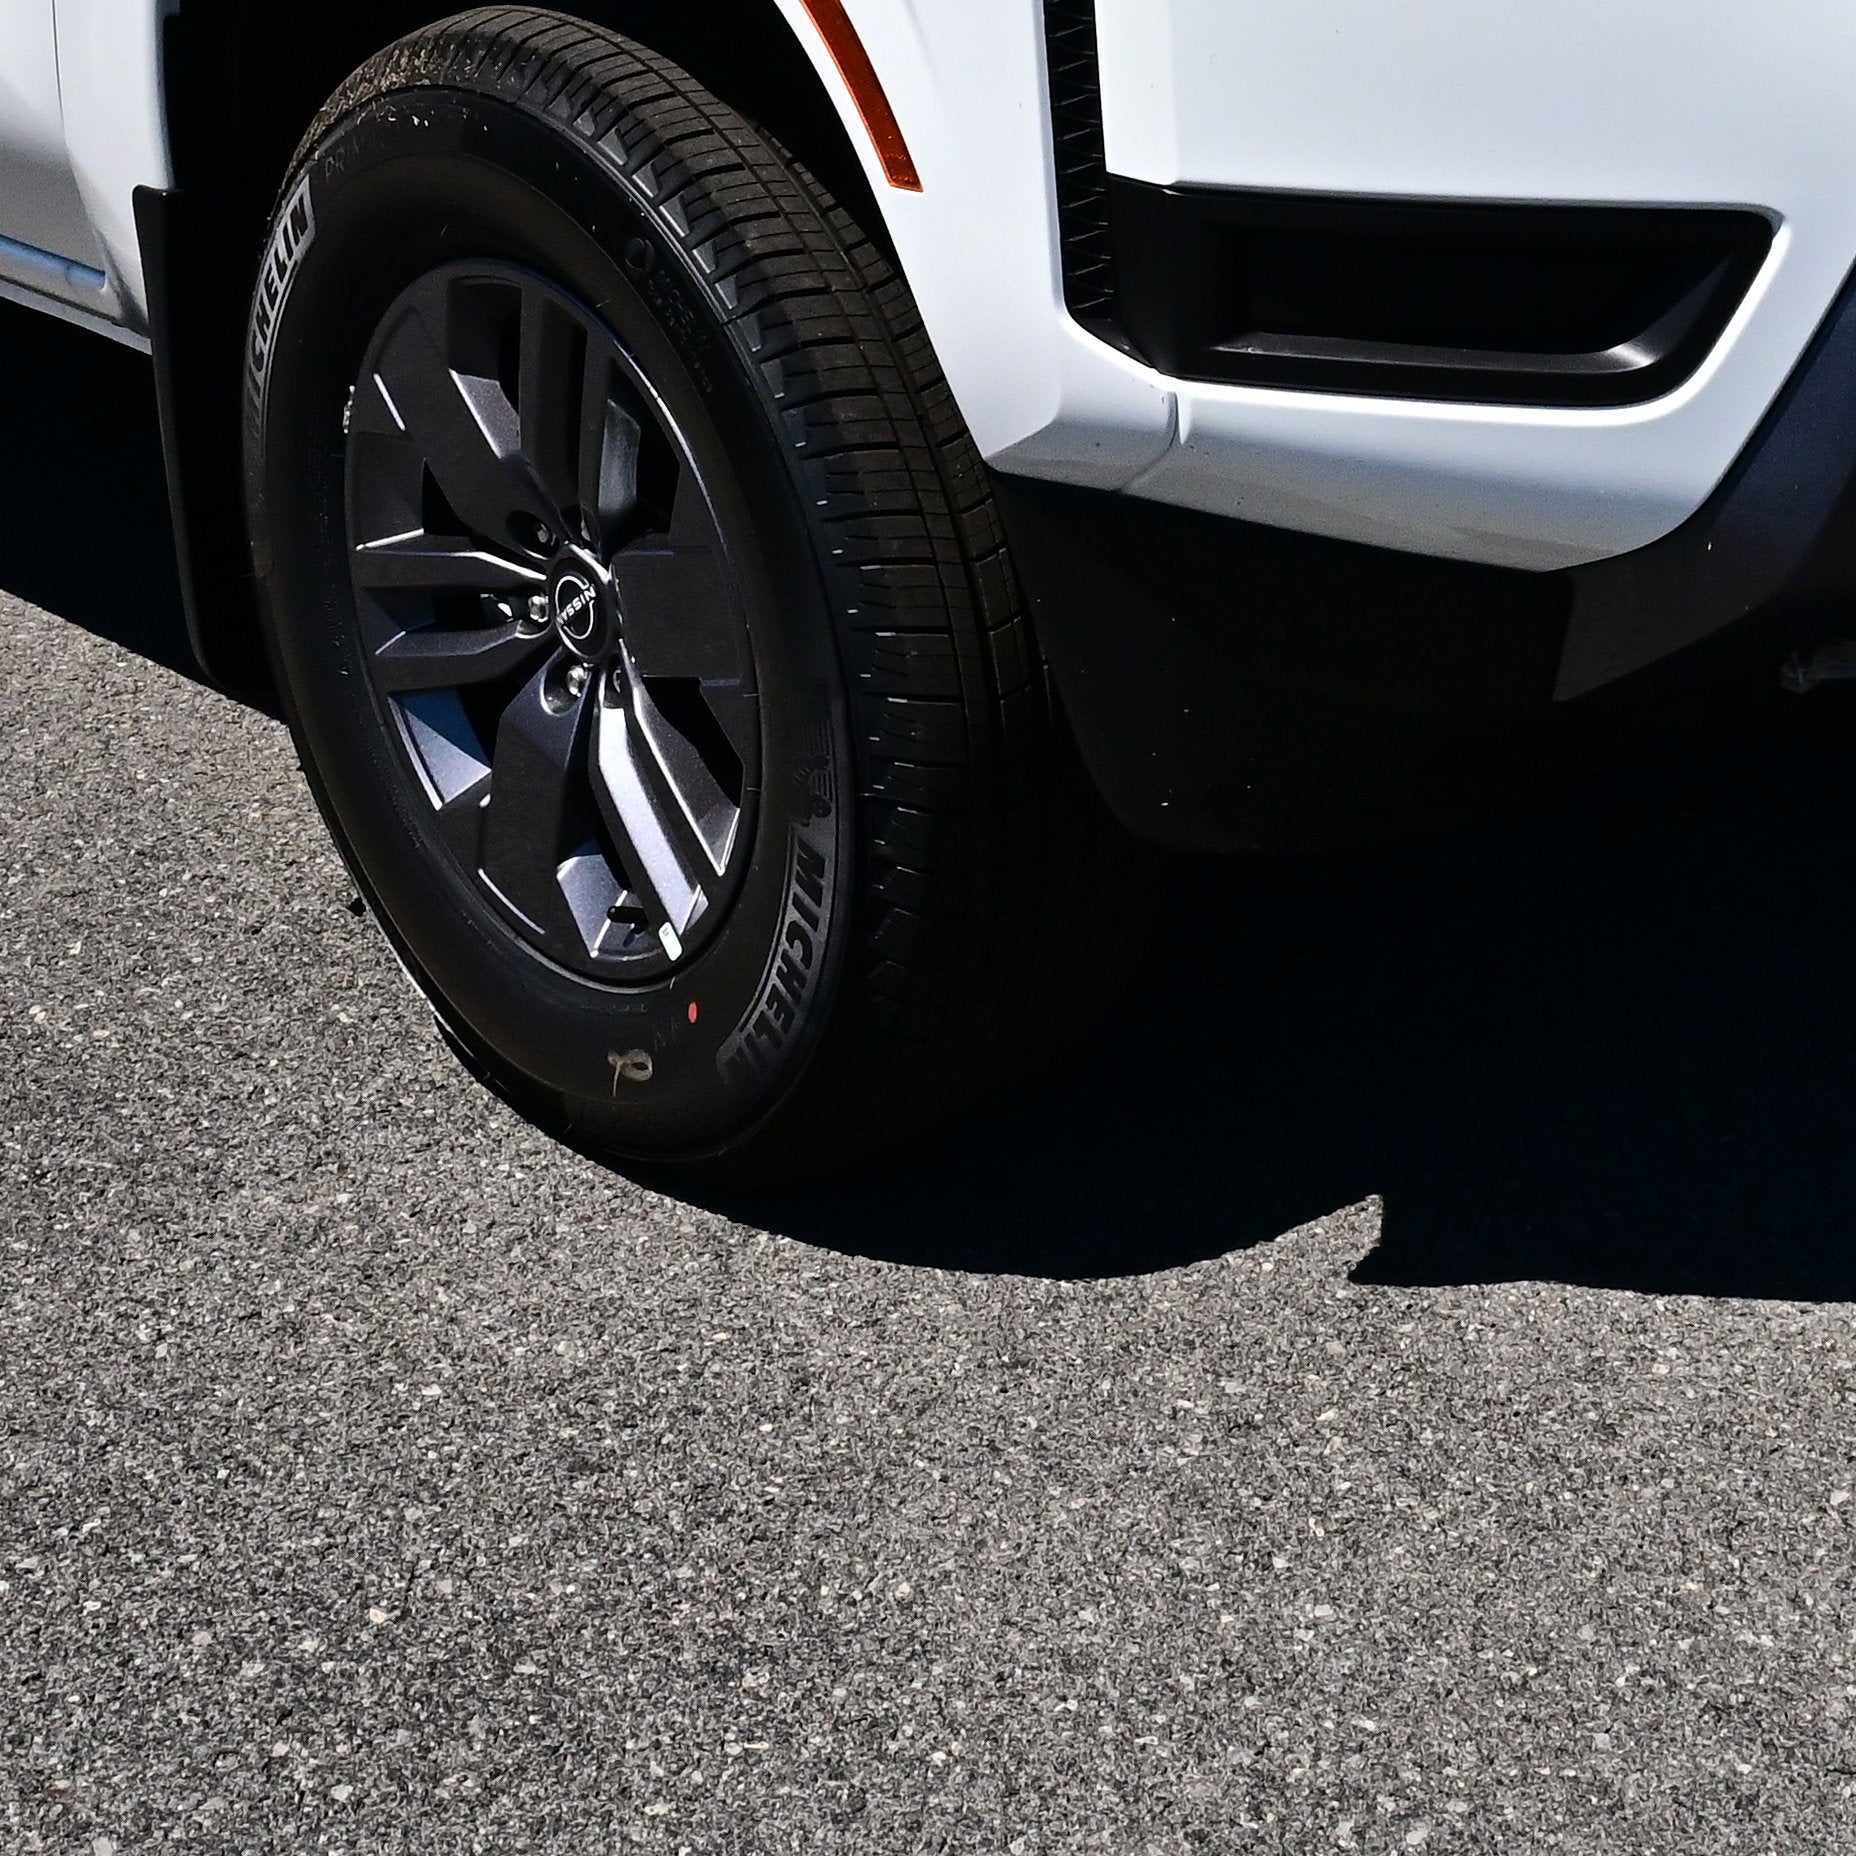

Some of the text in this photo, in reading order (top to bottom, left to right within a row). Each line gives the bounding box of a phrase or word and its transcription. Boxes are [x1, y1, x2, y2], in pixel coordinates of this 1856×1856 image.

[244, 192, 309, 432] MICHELIN
[556, 582, 597, 624] NISSAN
[725, 836, 826, 1086] MICHELIN
